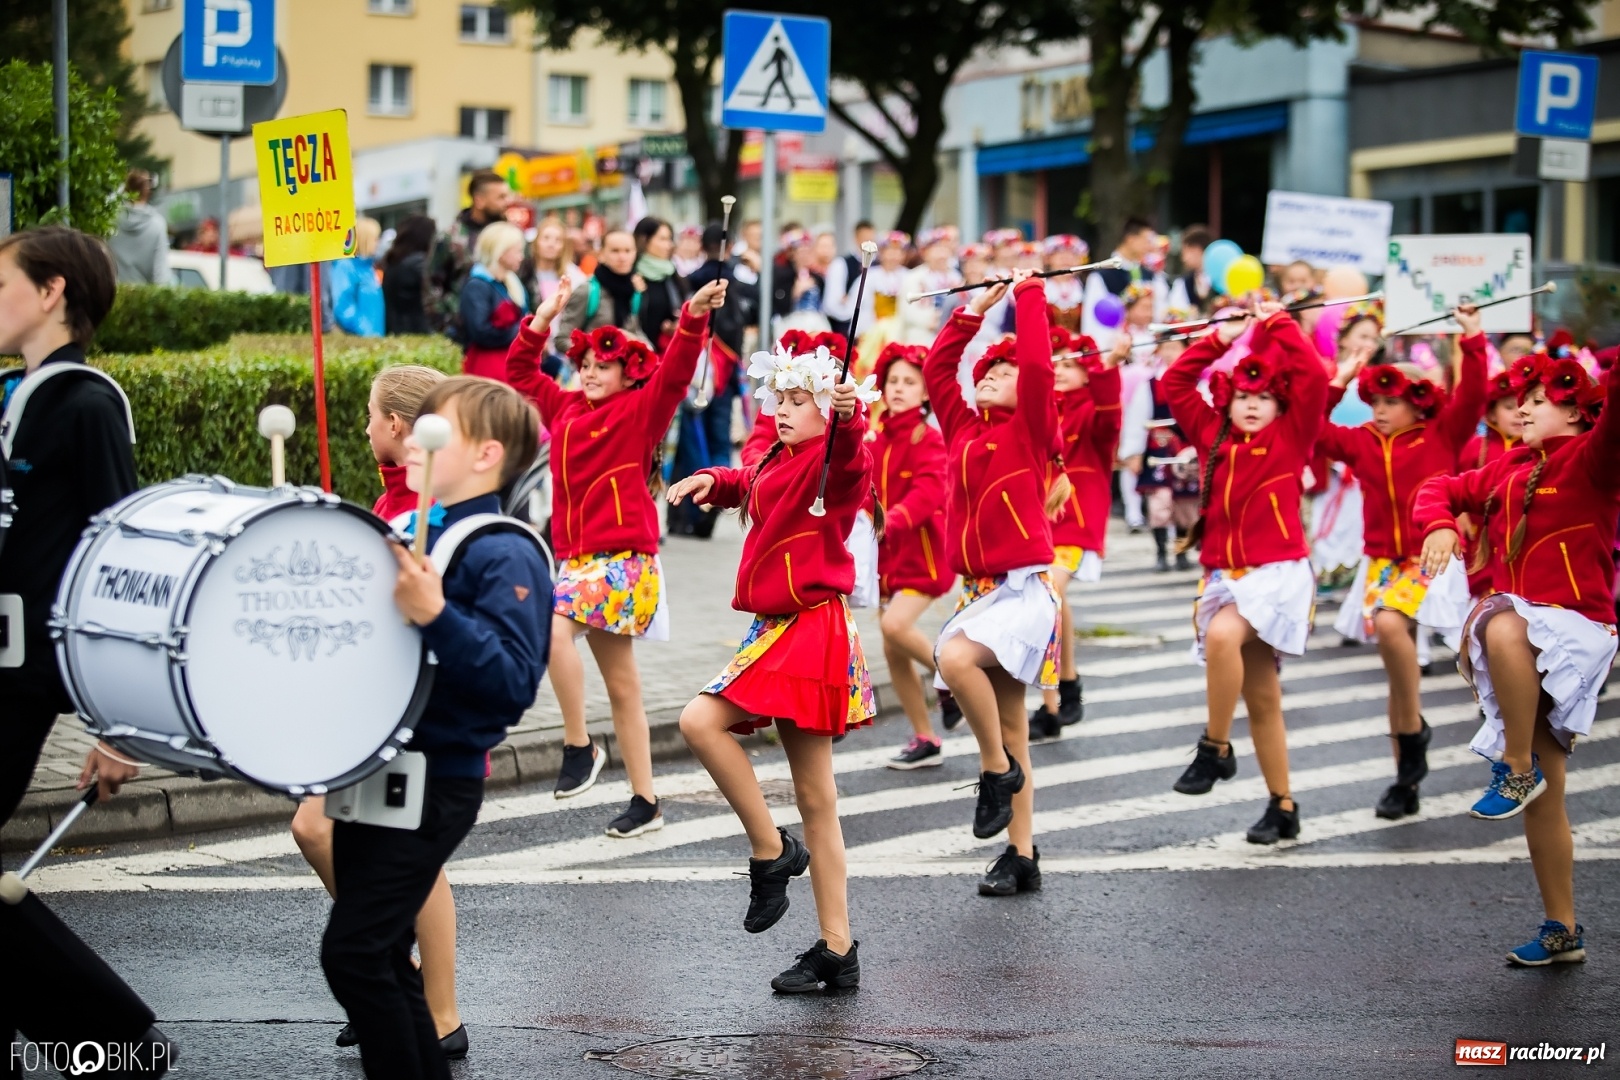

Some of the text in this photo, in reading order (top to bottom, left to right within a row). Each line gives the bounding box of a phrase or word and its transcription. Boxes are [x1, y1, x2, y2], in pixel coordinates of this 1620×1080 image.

[203, 0, 252, 67] P
[1536, 62, 1581, 125] P
[268, 132, 337, 195] TĘCZA
[275, 208, 341, 236] RACIBÓRZ
[93, 564, 178, 609] THOMANN
[237, 586, 367, 613] THOMANN
